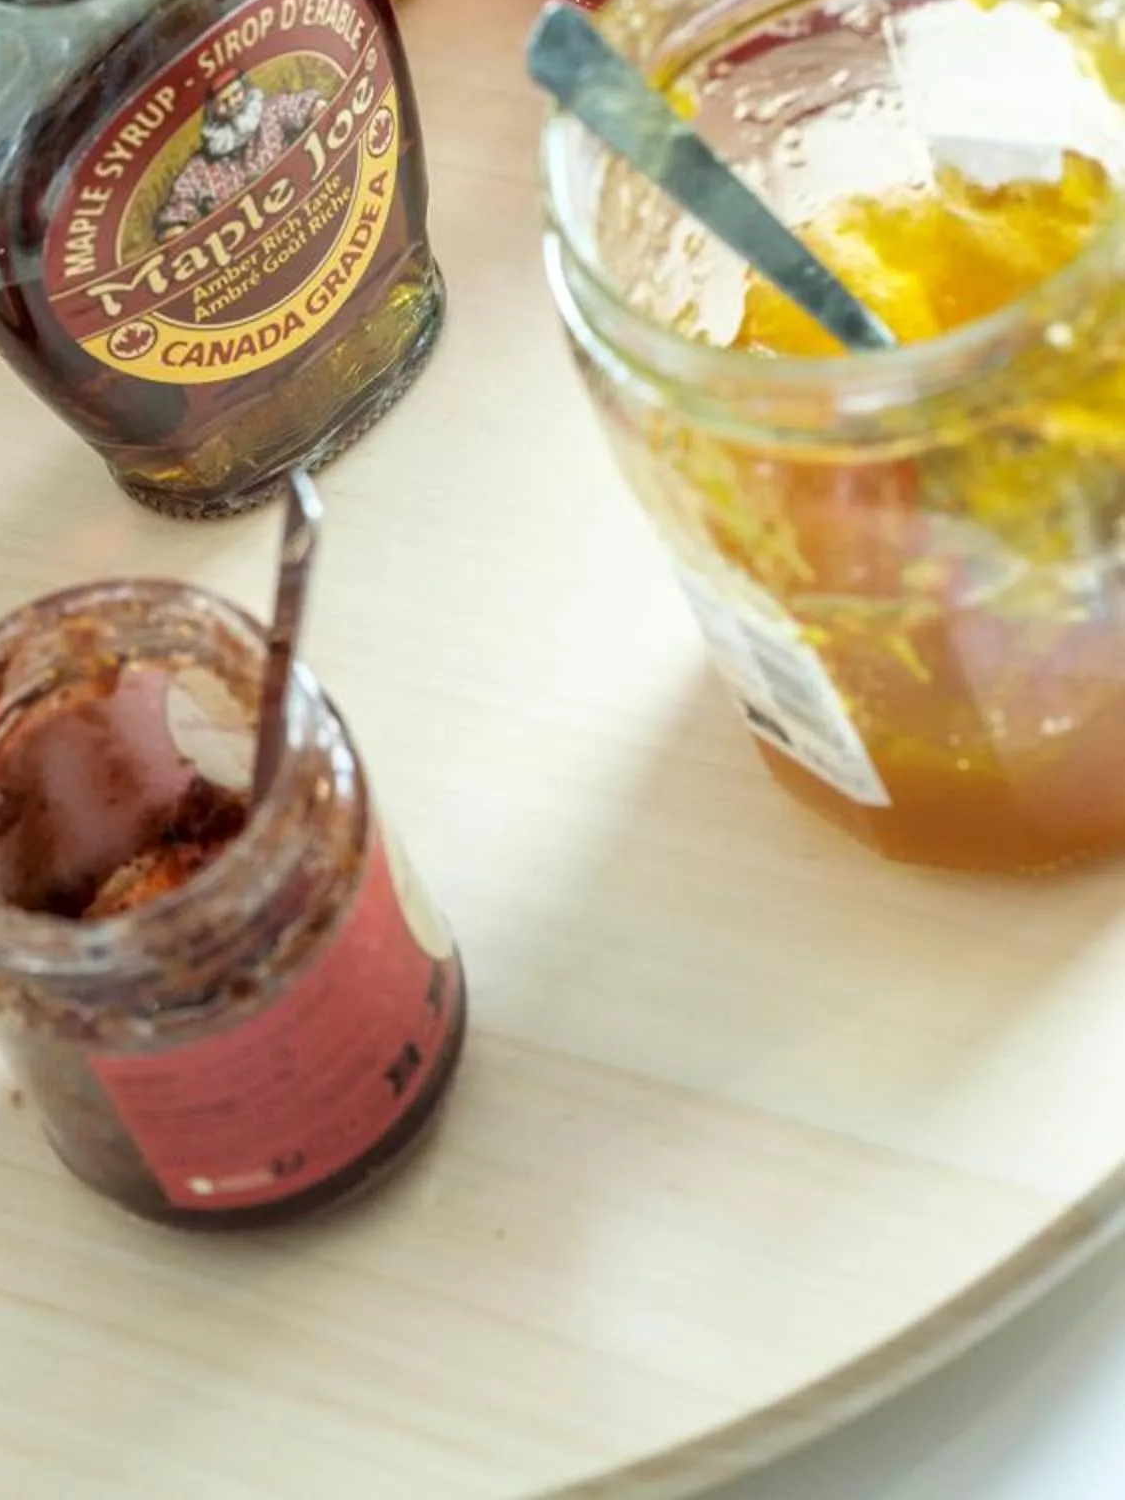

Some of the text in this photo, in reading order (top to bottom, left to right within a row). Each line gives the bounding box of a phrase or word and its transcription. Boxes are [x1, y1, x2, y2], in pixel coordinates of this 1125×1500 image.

[63, 185, 115, 278] MAPLE
[93, 84, 176, 180] SYRUP
[197, 5, 274, 80] SIROP
[86, 75, 375, 317] Maple Joe
[191, 174, 342, 305] Amber Rich Taste
[160, 170, 390, 369] CANADA GRADE A
[193, 185, 352, 324] Ambré Goût Riche
